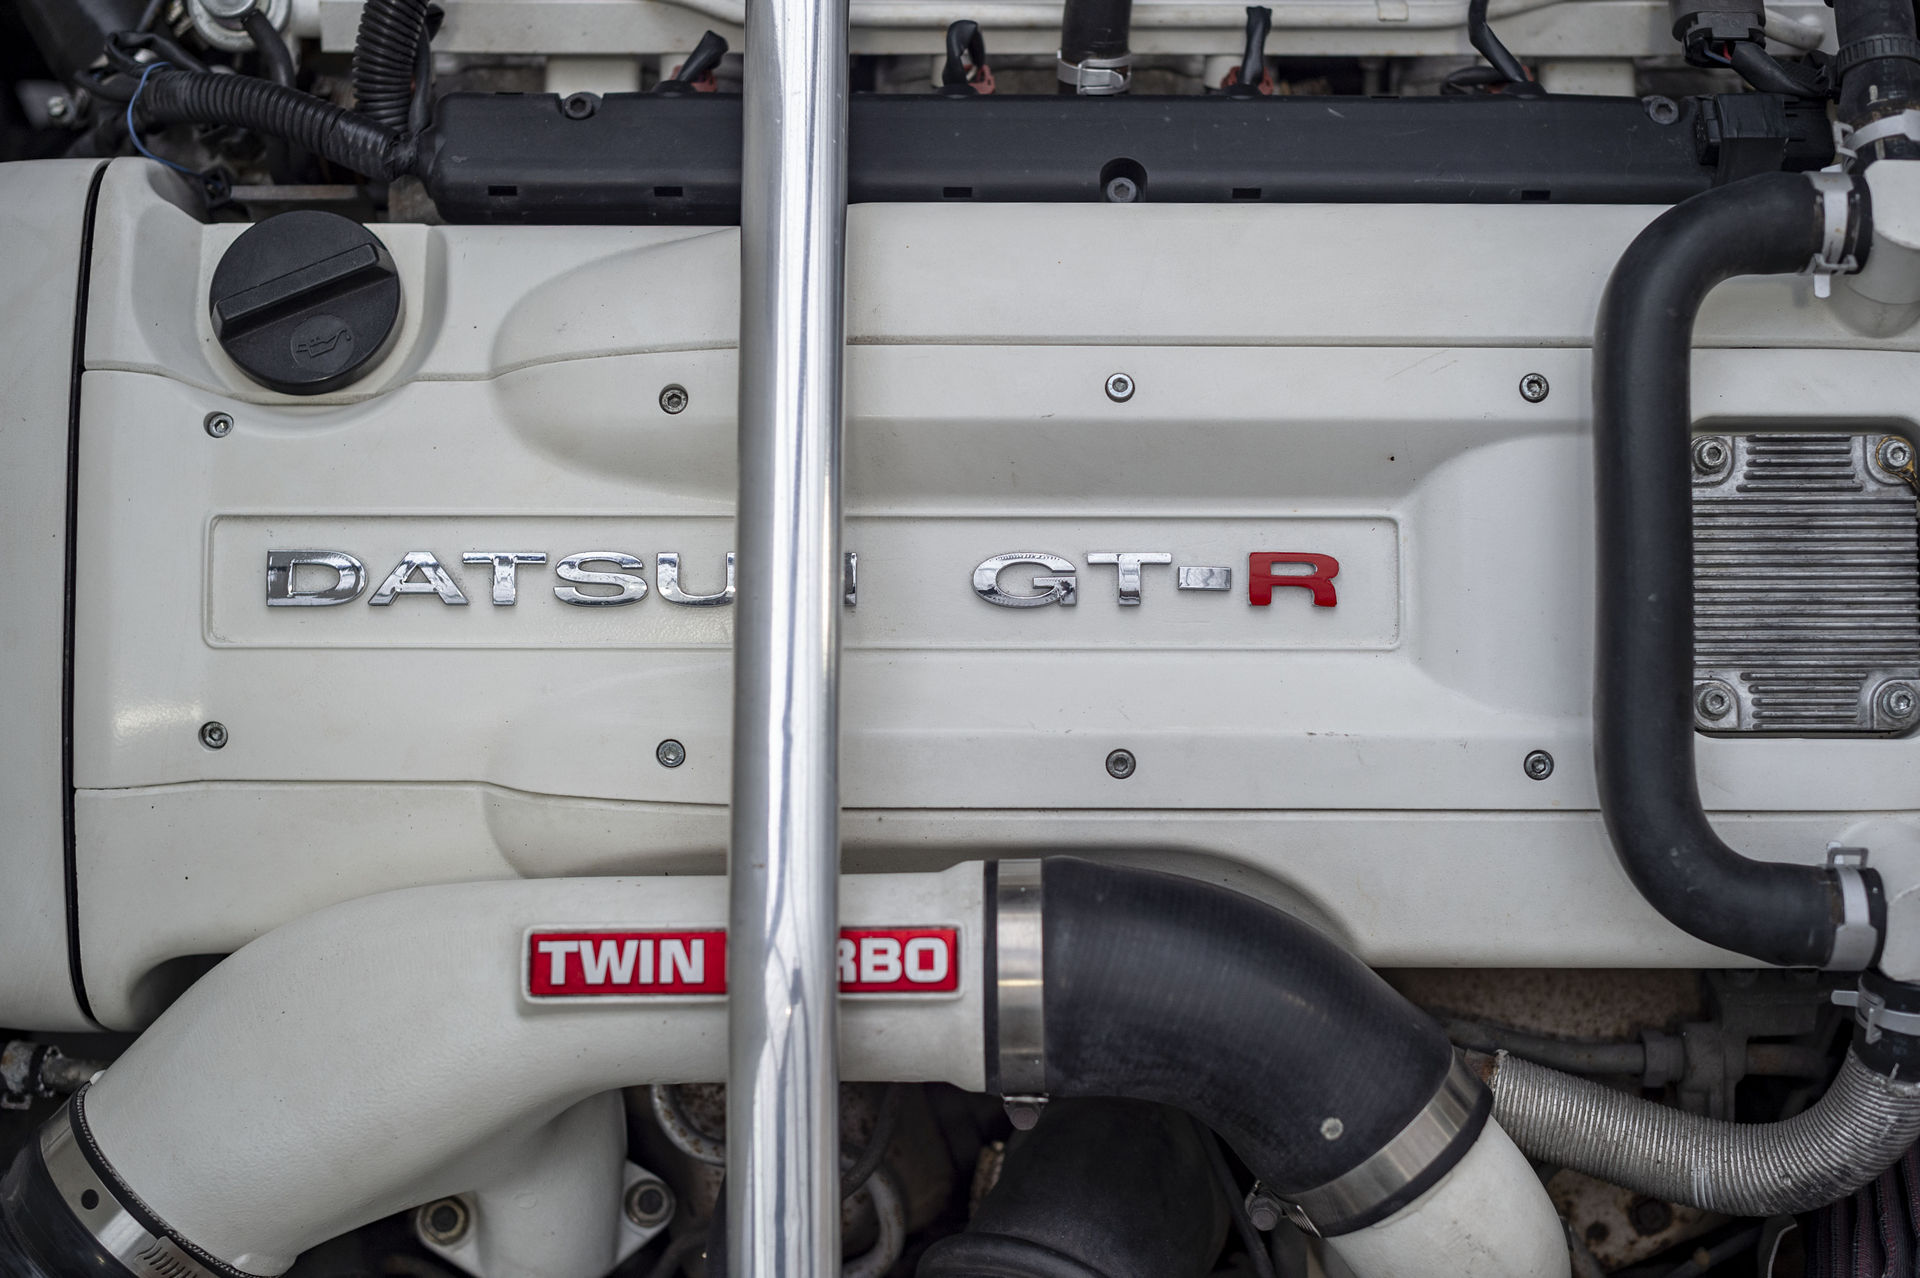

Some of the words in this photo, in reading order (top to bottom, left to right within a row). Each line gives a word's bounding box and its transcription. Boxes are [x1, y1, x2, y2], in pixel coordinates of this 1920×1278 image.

[266, 550, 858, 607] DATSU
[972, 552, 1340, 608] GT-R
[538, 938, 705, 985] TWIN
